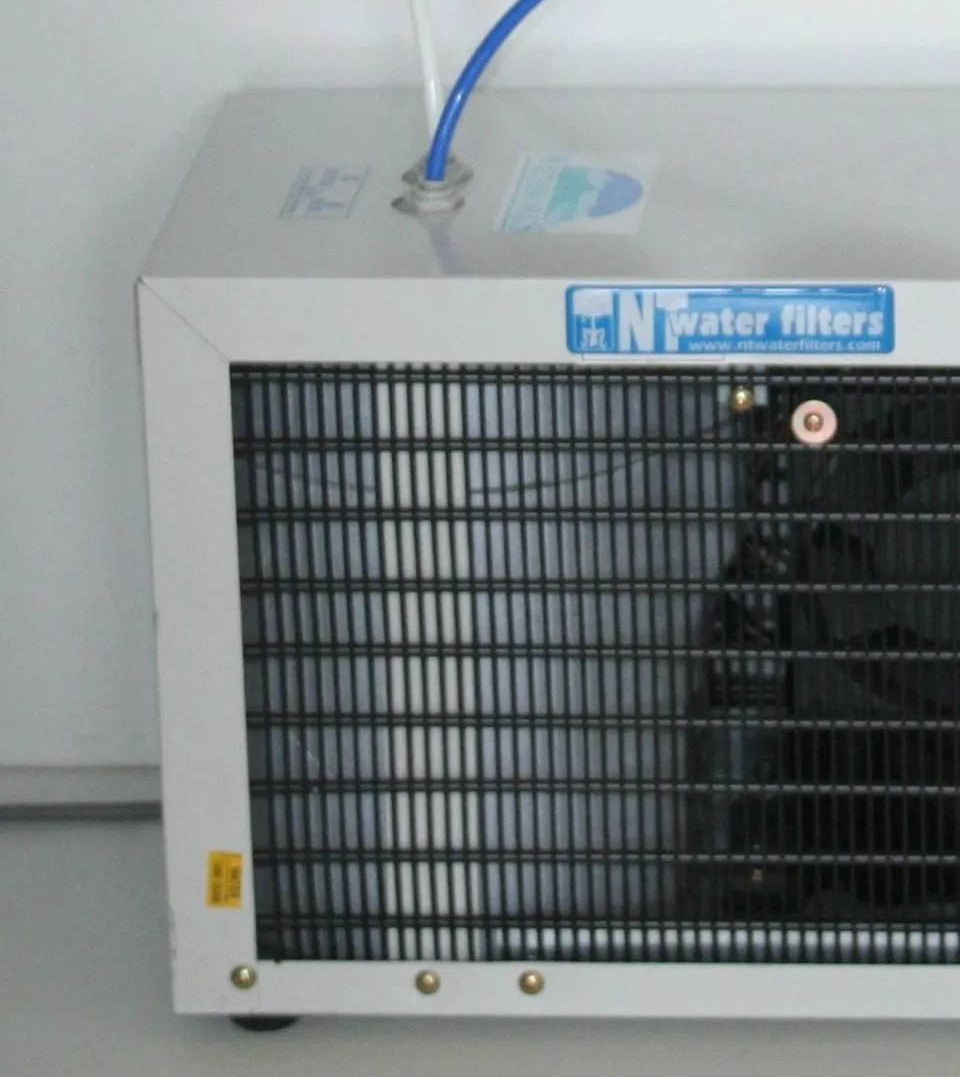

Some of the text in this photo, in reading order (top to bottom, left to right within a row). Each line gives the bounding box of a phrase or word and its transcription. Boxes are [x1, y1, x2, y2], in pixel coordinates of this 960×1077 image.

[618, 291, 884, 351] NT water filters
[688, 339, 880, 352] www.ntwaterfilters.com
